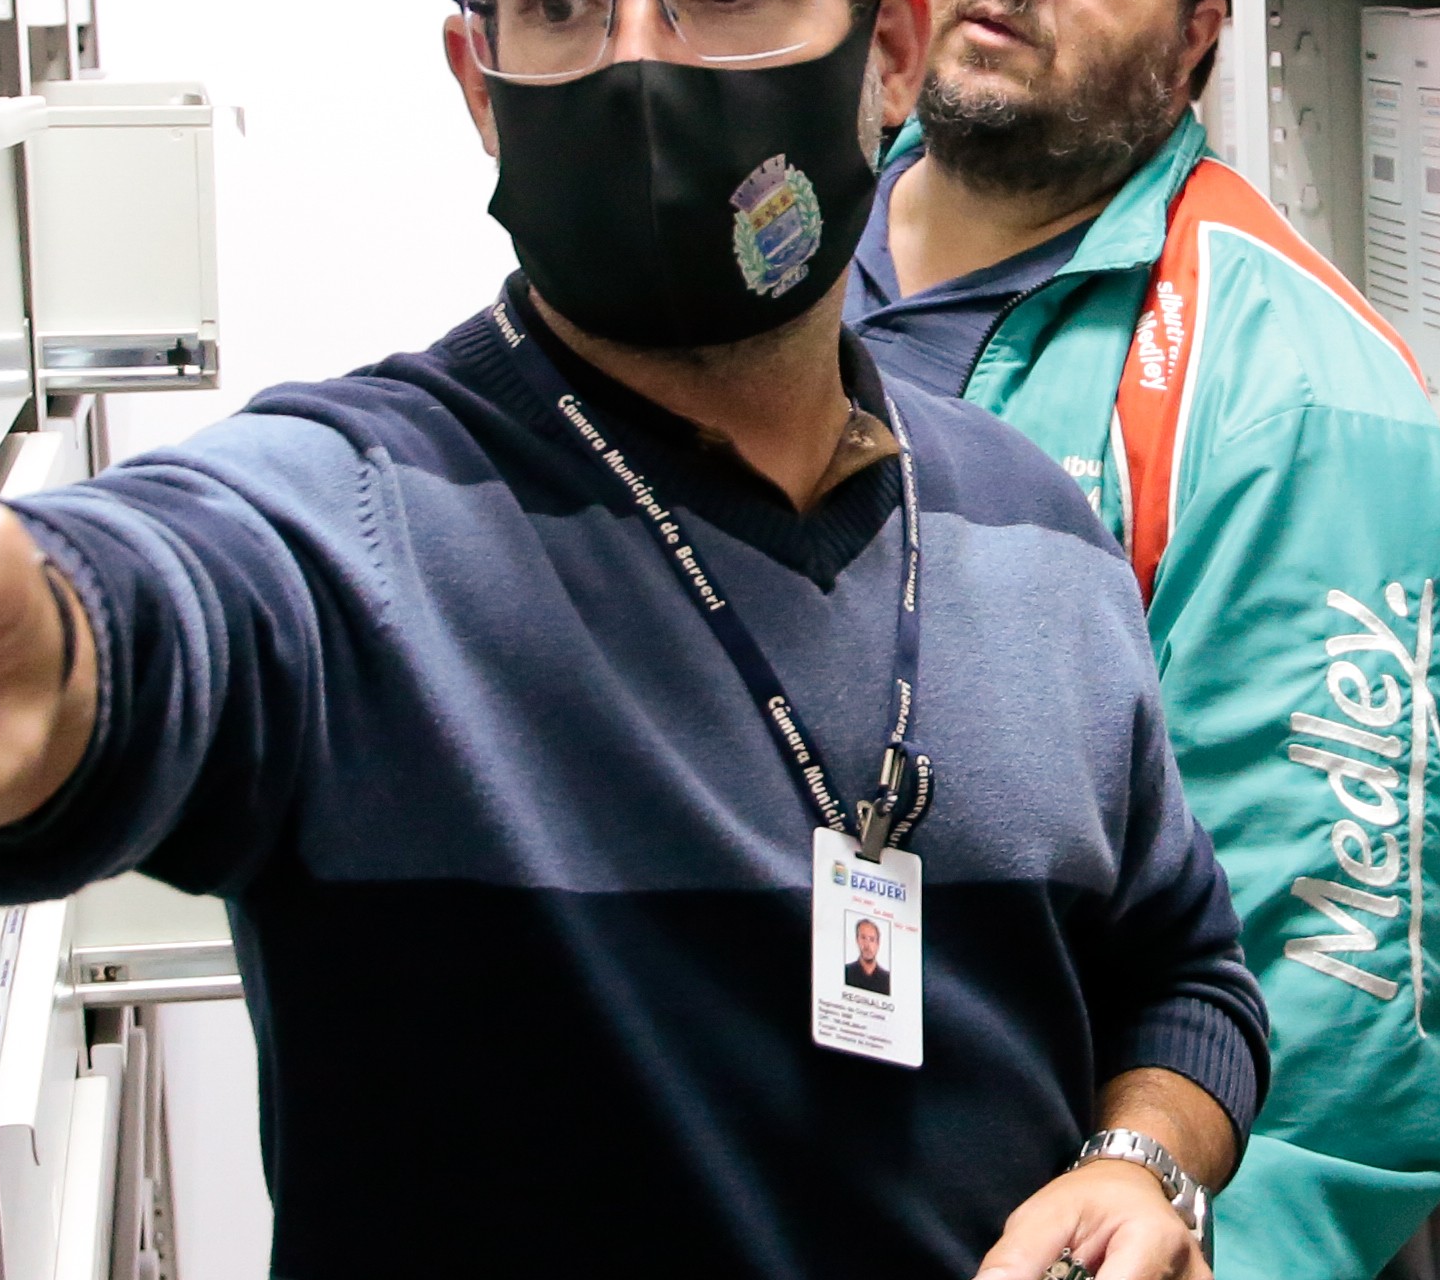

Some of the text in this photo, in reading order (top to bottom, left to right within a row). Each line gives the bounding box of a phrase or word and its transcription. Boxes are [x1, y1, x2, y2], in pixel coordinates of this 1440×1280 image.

[602, 449, 670, 521] Municipal
[660, 523, 680, 545] de
[675, 545, 726, 611] Barueri
[767, 694, 848, 832] Câmara Municip
[850, 874, 906, 902] BARUERI
